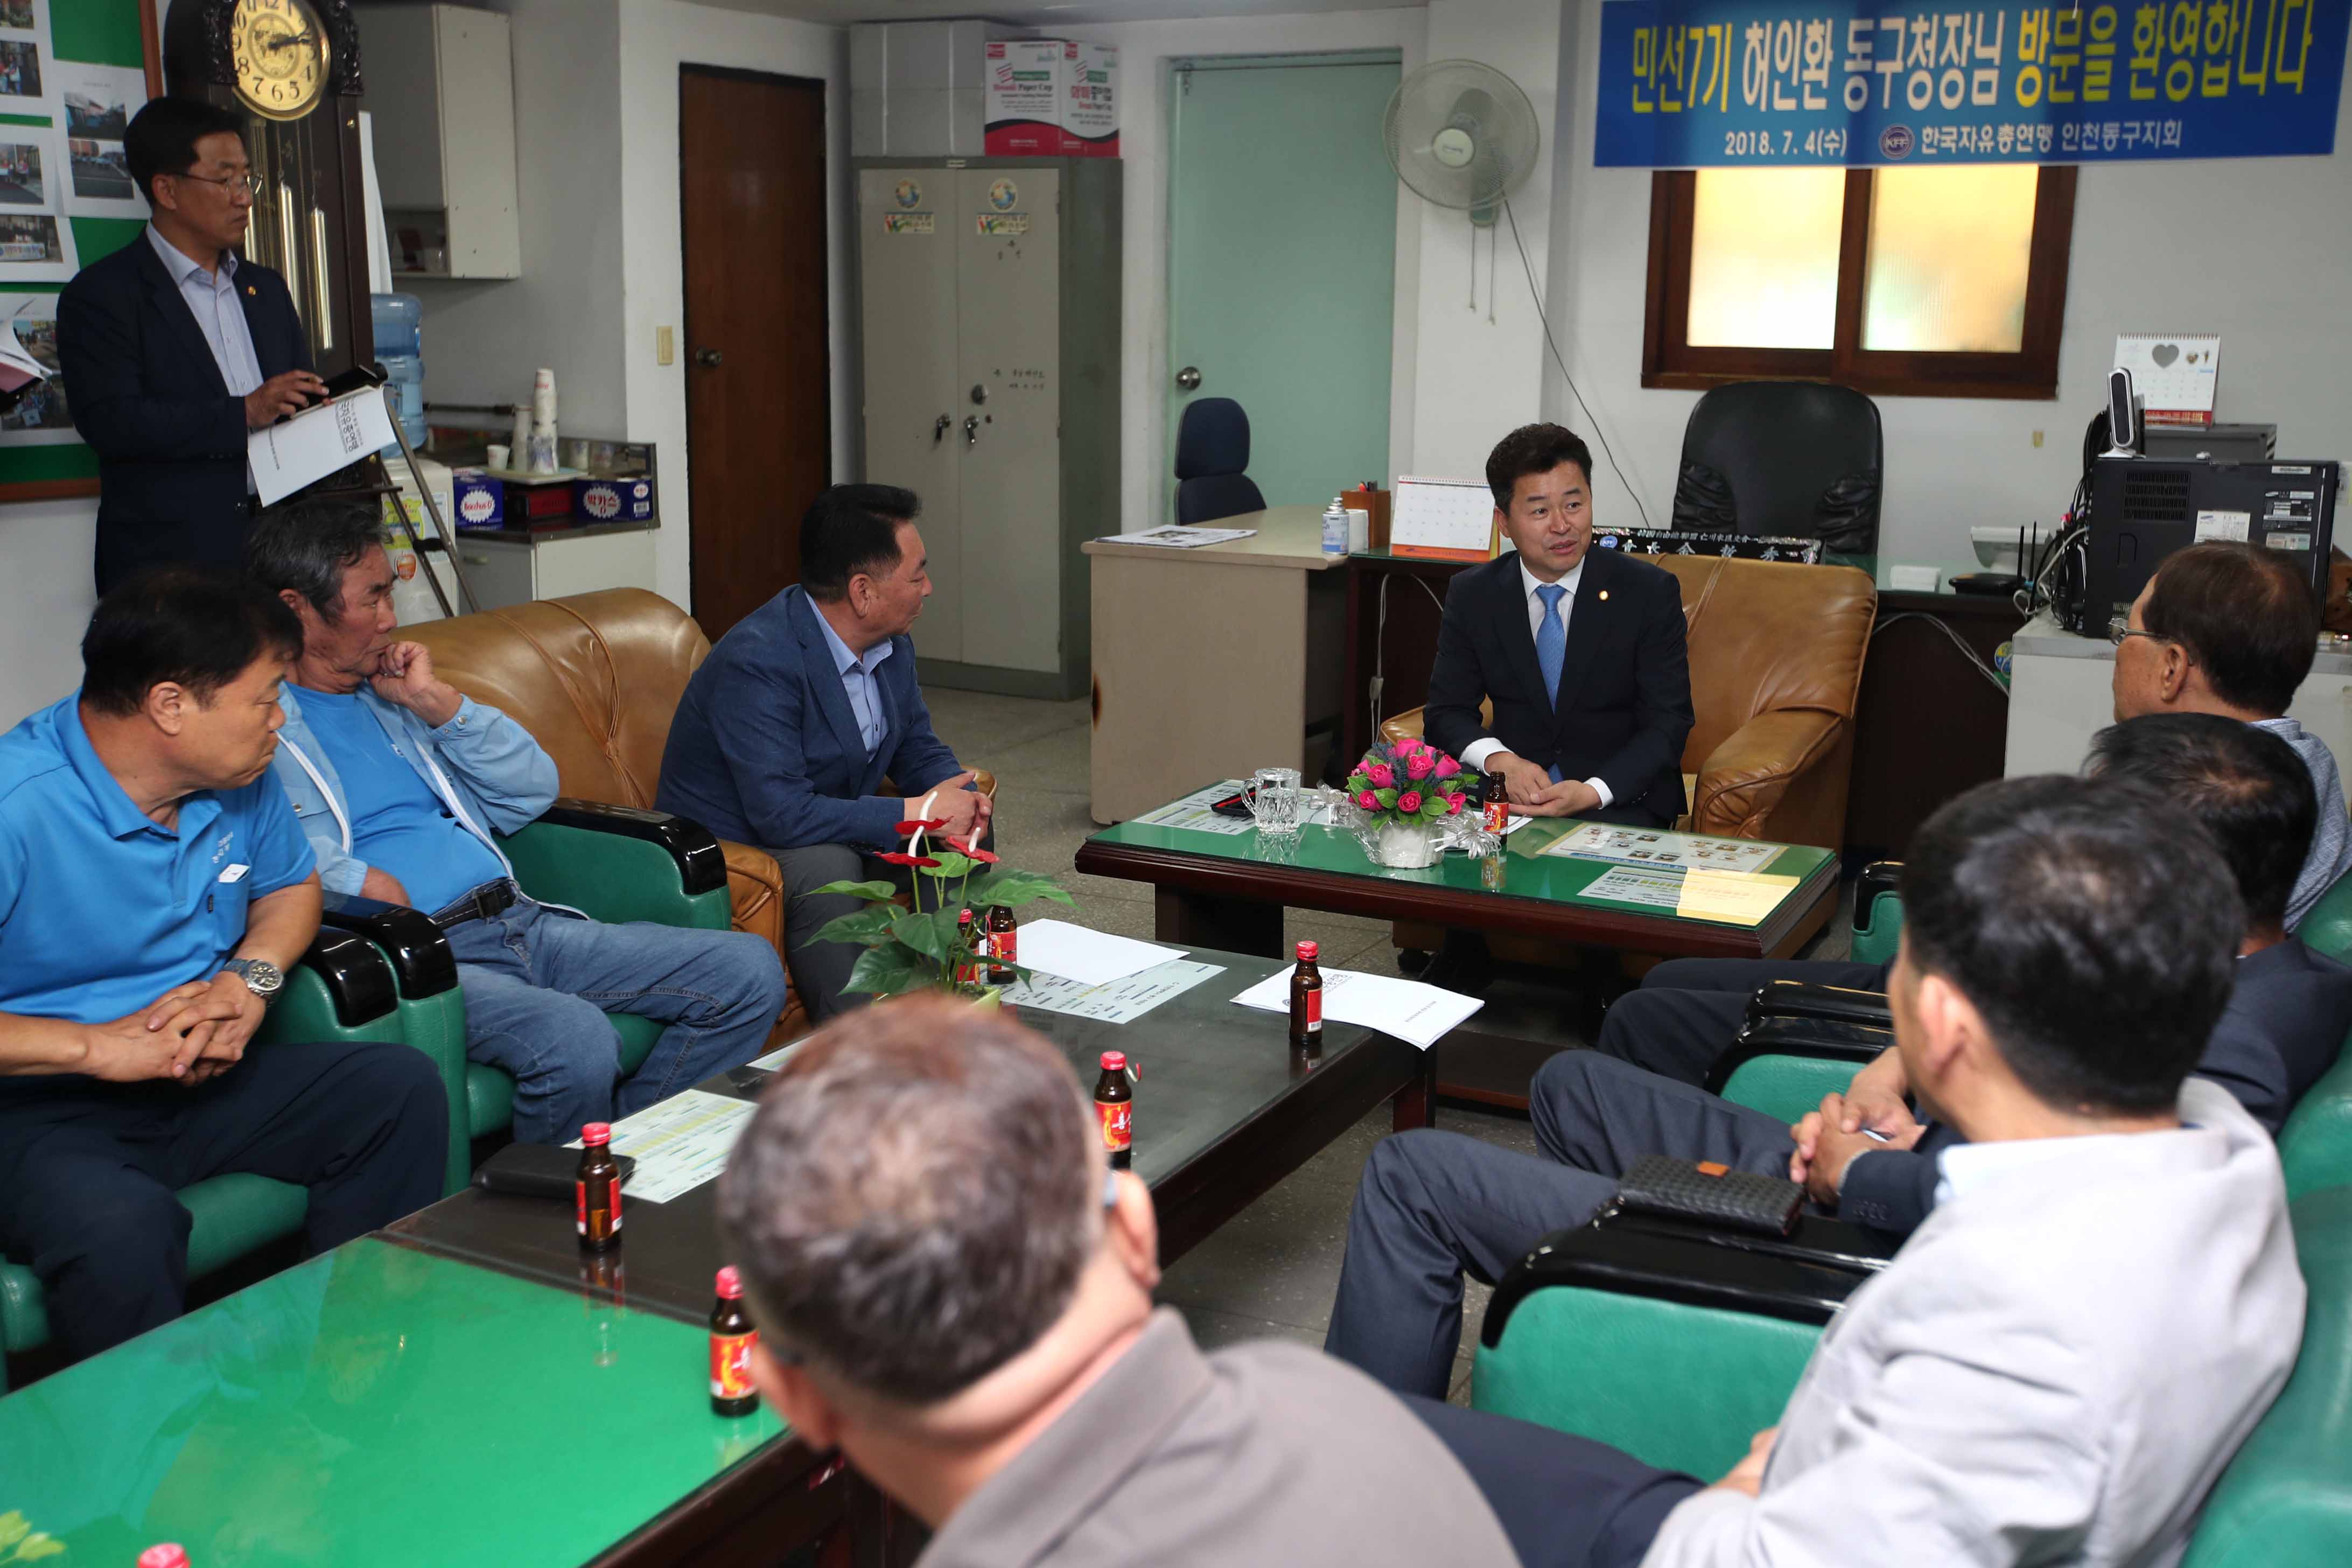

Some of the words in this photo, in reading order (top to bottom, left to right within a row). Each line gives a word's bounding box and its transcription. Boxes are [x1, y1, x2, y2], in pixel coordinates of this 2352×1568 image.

[1632, 23, 1733, 113] 민선7기
[1742, 18, 1834, 112] 허인환
[1843, 10, 2005, 113] 동구청장님
[2015, 5, 2118, 108] 방문을
[2129, 0, 2313, 102] 환영합니다
[238, 57, 250, 76] 8
[253, 77, 264, 95] 7
[272, 84, 283, 102] 6
[289, 81, 299, 100] 5
[1725, 130, 1775, 156] 2018.
[1804, 128, 1848, 157] 4(수)
[1921, 122, 2054, 155] 한국자유총연맹
[2061, 118, 2183, 151] 인천동구지회
